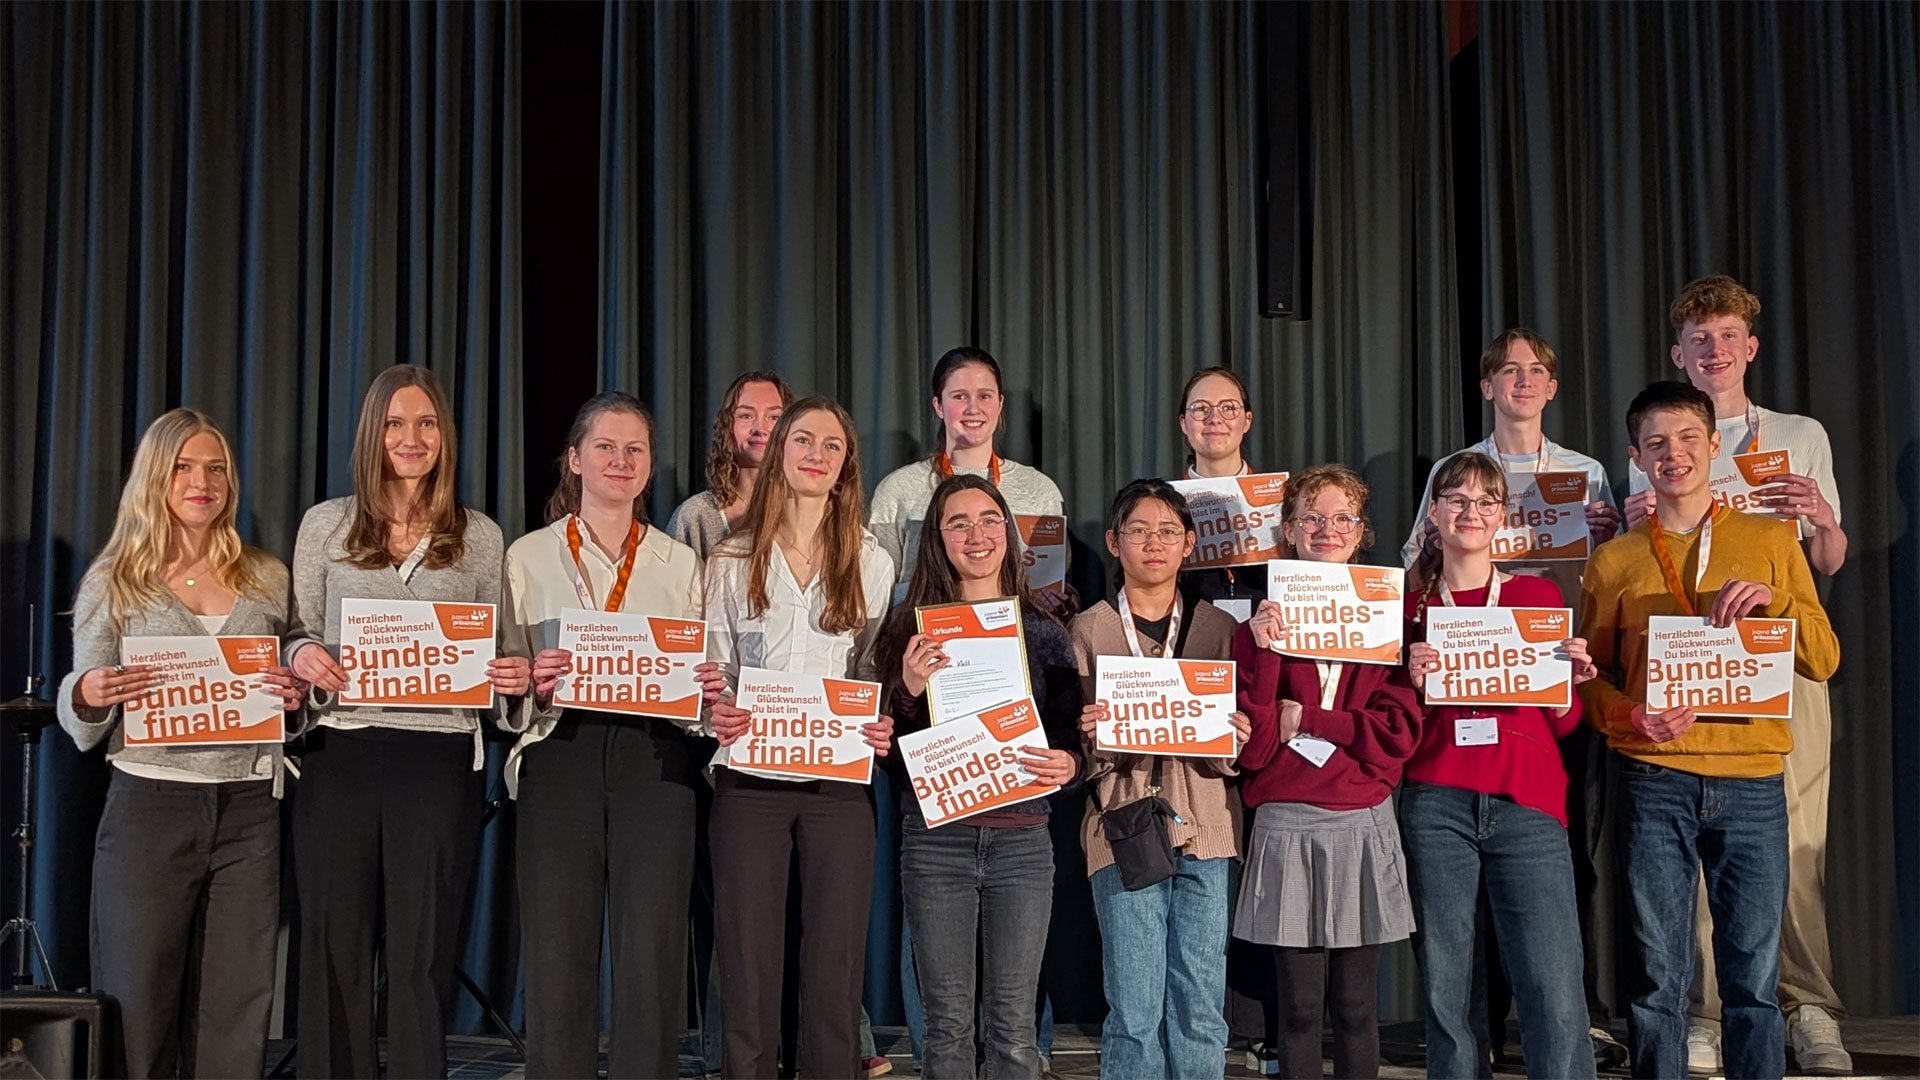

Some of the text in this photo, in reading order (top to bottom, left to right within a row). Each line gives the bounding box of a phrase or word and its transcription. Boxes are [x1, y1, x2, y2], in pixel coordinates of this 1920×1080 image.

[1190, 494, 1239, 509] ückwunsch!
[1196, 510, 1275, 538] ndes-
[1274, 574, 1321, 583] Herzlichen
[1288, 583, 1349, 592] Glückwunsch!
[1284, 594, 1295, 602] Du
[1285, 600, 1384, 624] undes-
[348, 614, 402, 624] Herzlichen
[1433, 619, 1483, 630] Herzlichen
[363, 622, 434, 634] Glückwunsch!
[567, 624, 618, 632] Herzlichen
[933, 626, 962, 635] Urkunde
[1447, 626, 1512, 639] Glückwunsch!
[359, 635, 409, 645] Du bist im
[581, 634, 648, 642] Glückwunsch!
[1283, 625, 1364, 650] finale
[1655, 630, 1706, 640] Herzlichen
[576, 643, 589, 651] Du
[591, 643, 610, 651] bist
[1443, 638, 1490, 649] Du bist im
[1669, 637, 1735, 649] Glückwunsch!
[130, 651, 186, 663] Herzlichen
[342, 640, 474, 671] Bundes-
[1665, 651, 1677, 659] Du
[1680, 650, 1698, 658] bist
[149, 657, 220, 673] lückwunsch!
[1649, 654, 1773, 683] Bundes-
[159, 673, 178, 682] bist
[182, 671, 195, 680] im
[1103, 670, 1150, 680] Herzlichen
[357, 668, 451, 698] finale
[744, 684, 793, 693] Herzlichen
[1116, 678, 1179, 689] Glückwunsch!
[1442, 669, 1529, 698] finale
[572, 677, 661, 702] finale
[1112, 689, 1157, 699] Du bist im
[1664, 680, 1751, 709] finale
[757, 695, 821, 704] Glückwunsch!
[752, 705, 798, 713] Du bist im
[143, 704, 241, 739] finale
[742, 712, 856, 738] undes-
[1113, 720, 1196, 745] finale
[747, 739, 833, 765] finale
[909, 735, 956, 759] Herzlichen
[924, 732, 986, 763] Glückwunsch!
[924, 752, 968, 774] Du bist im
[937, 772, 1019, 815] finale
